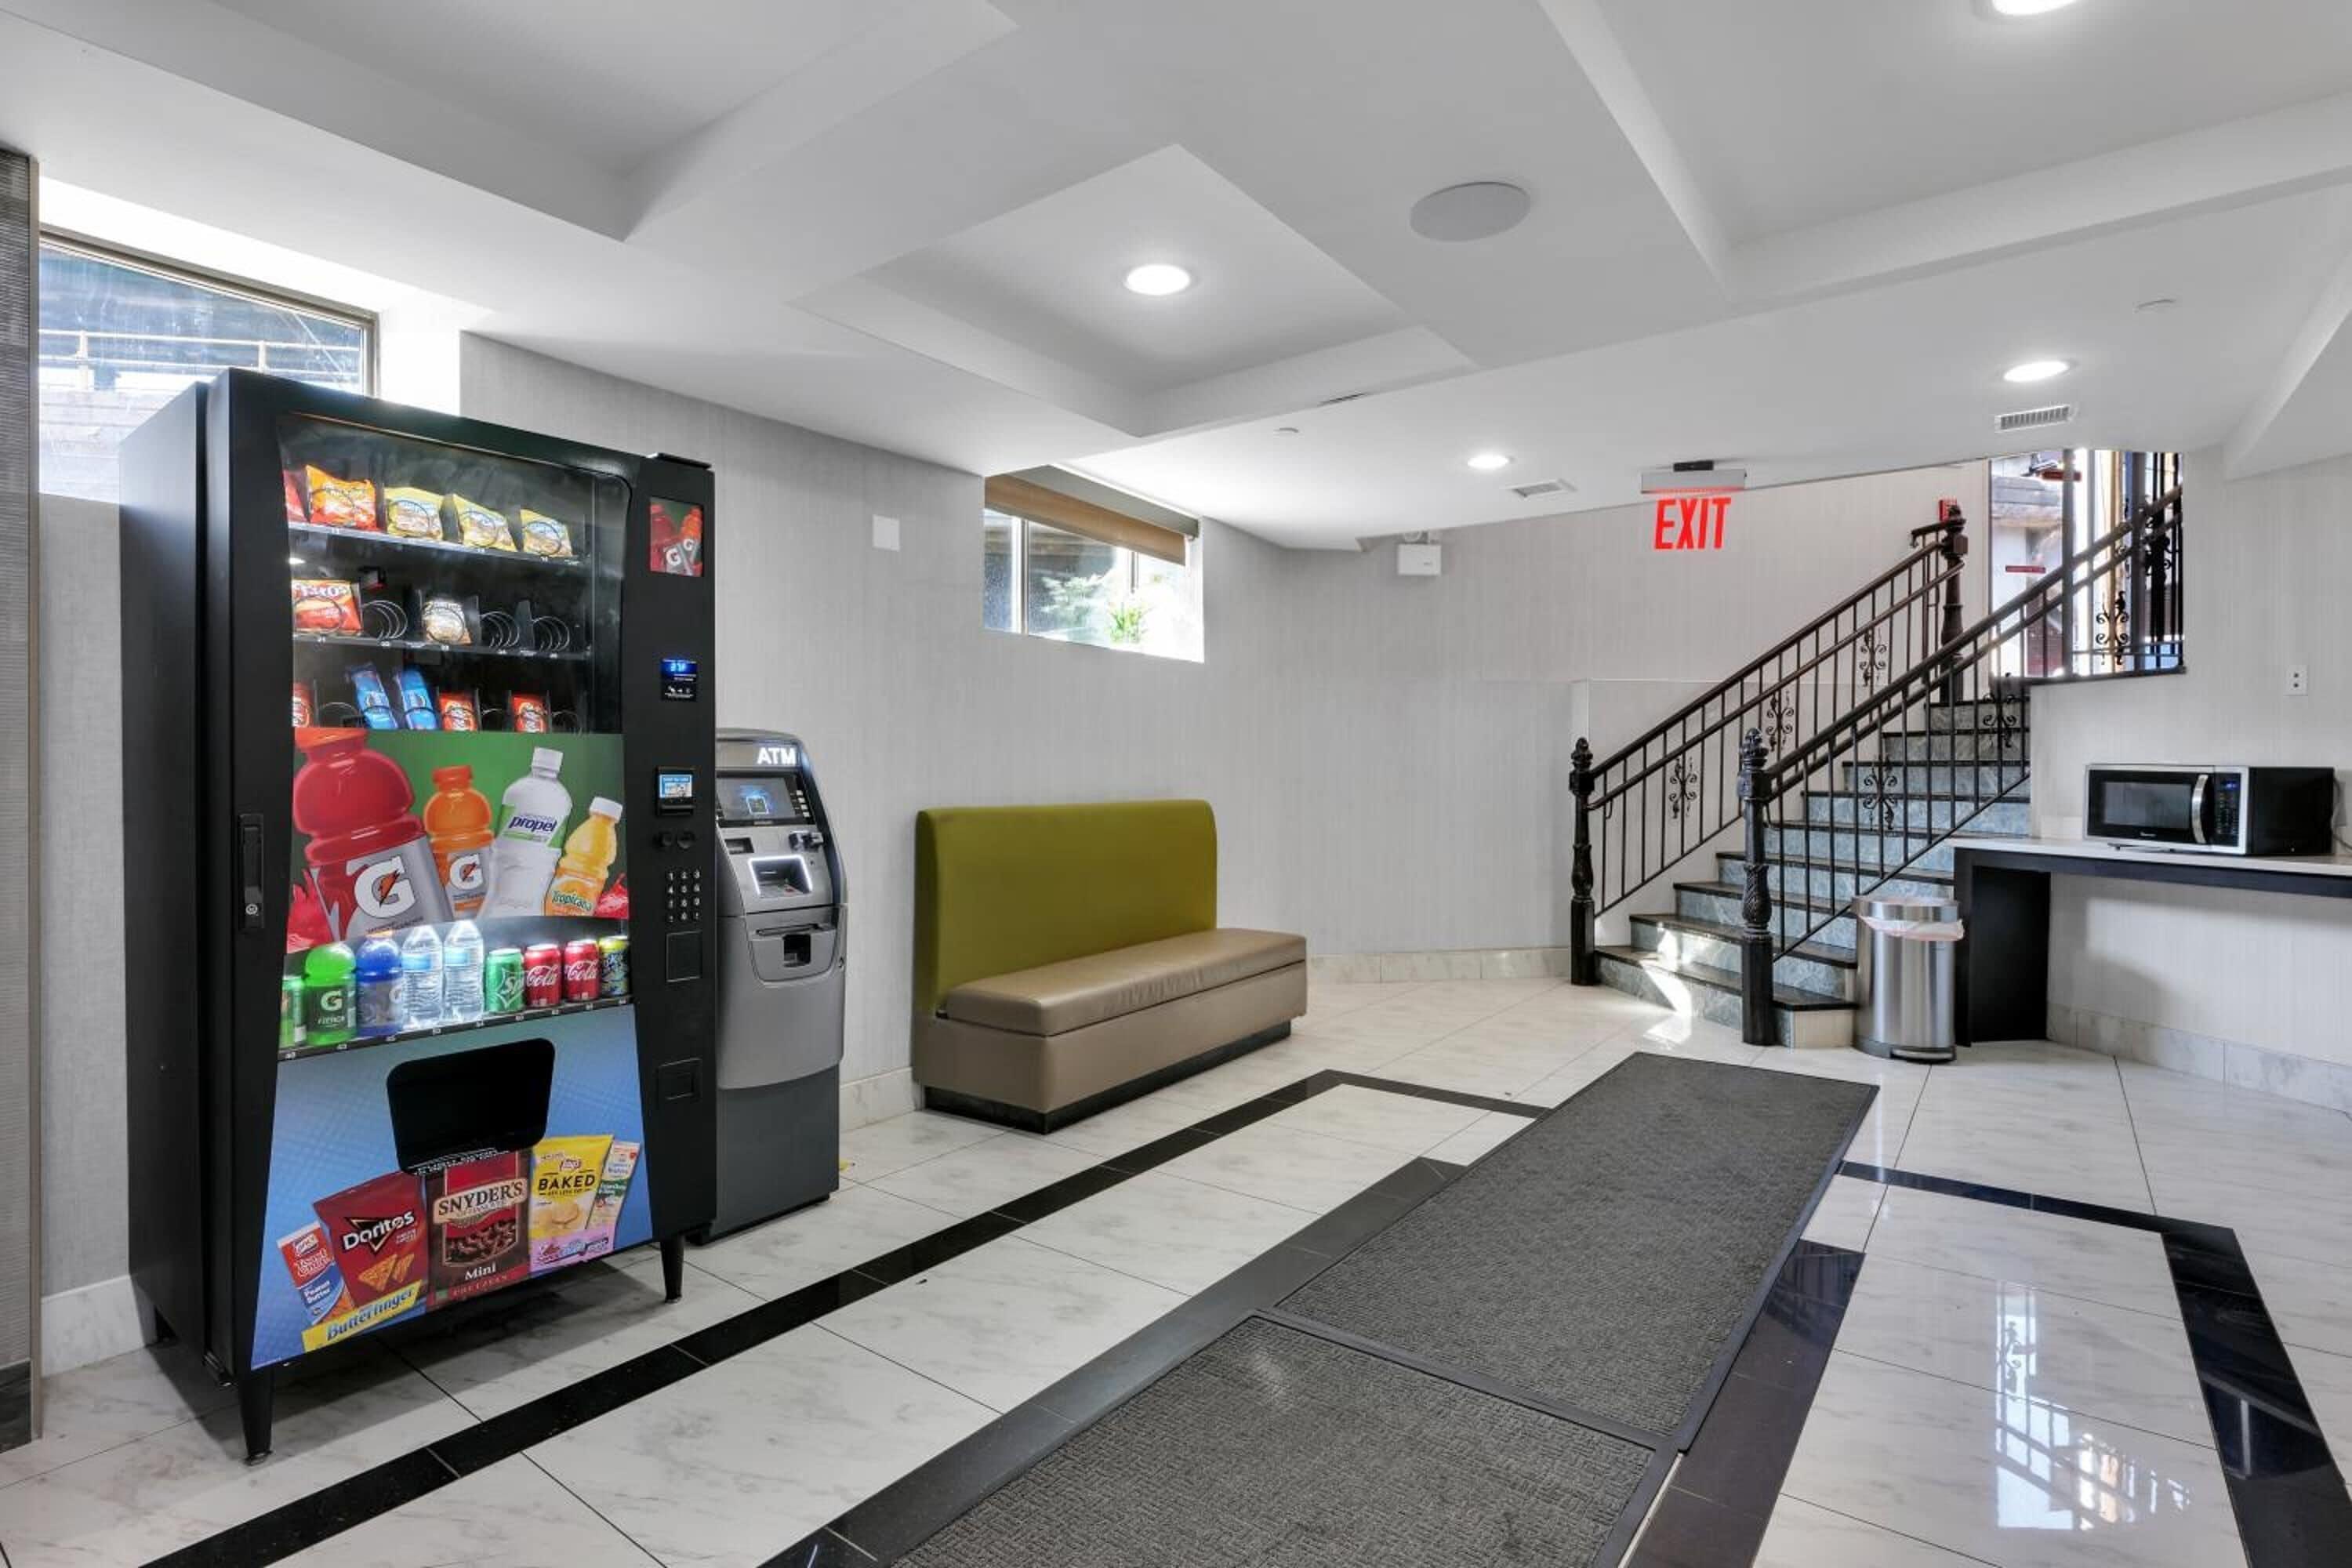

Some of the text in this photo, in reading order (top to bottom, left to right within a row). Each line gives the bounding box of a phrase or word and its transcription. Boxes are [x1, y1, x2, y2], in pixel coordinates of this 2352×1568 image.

[1654, 496, 1732, 550] EXIT
[666, 548, 682, 566] G
[757, 746, 797, 765] ATM
[508, 815, 558, 833] propel
[449, 852, 485, 891] G
[354, 854, 416, 920] G
[551, 890, 592, 912] Tropicana
[526, 964, 560, 987] Cola
[320, 990, 343, 1011] G
[538, 1174, 596, 1192] BAKED
[437, 1180, 524, 1217] SNYDER'S
[342, 1210, 416, 1251] Doritos
[464, 1261, 497, 1281] Mini
[327, 1288, 414, 1341] Butterfinger
